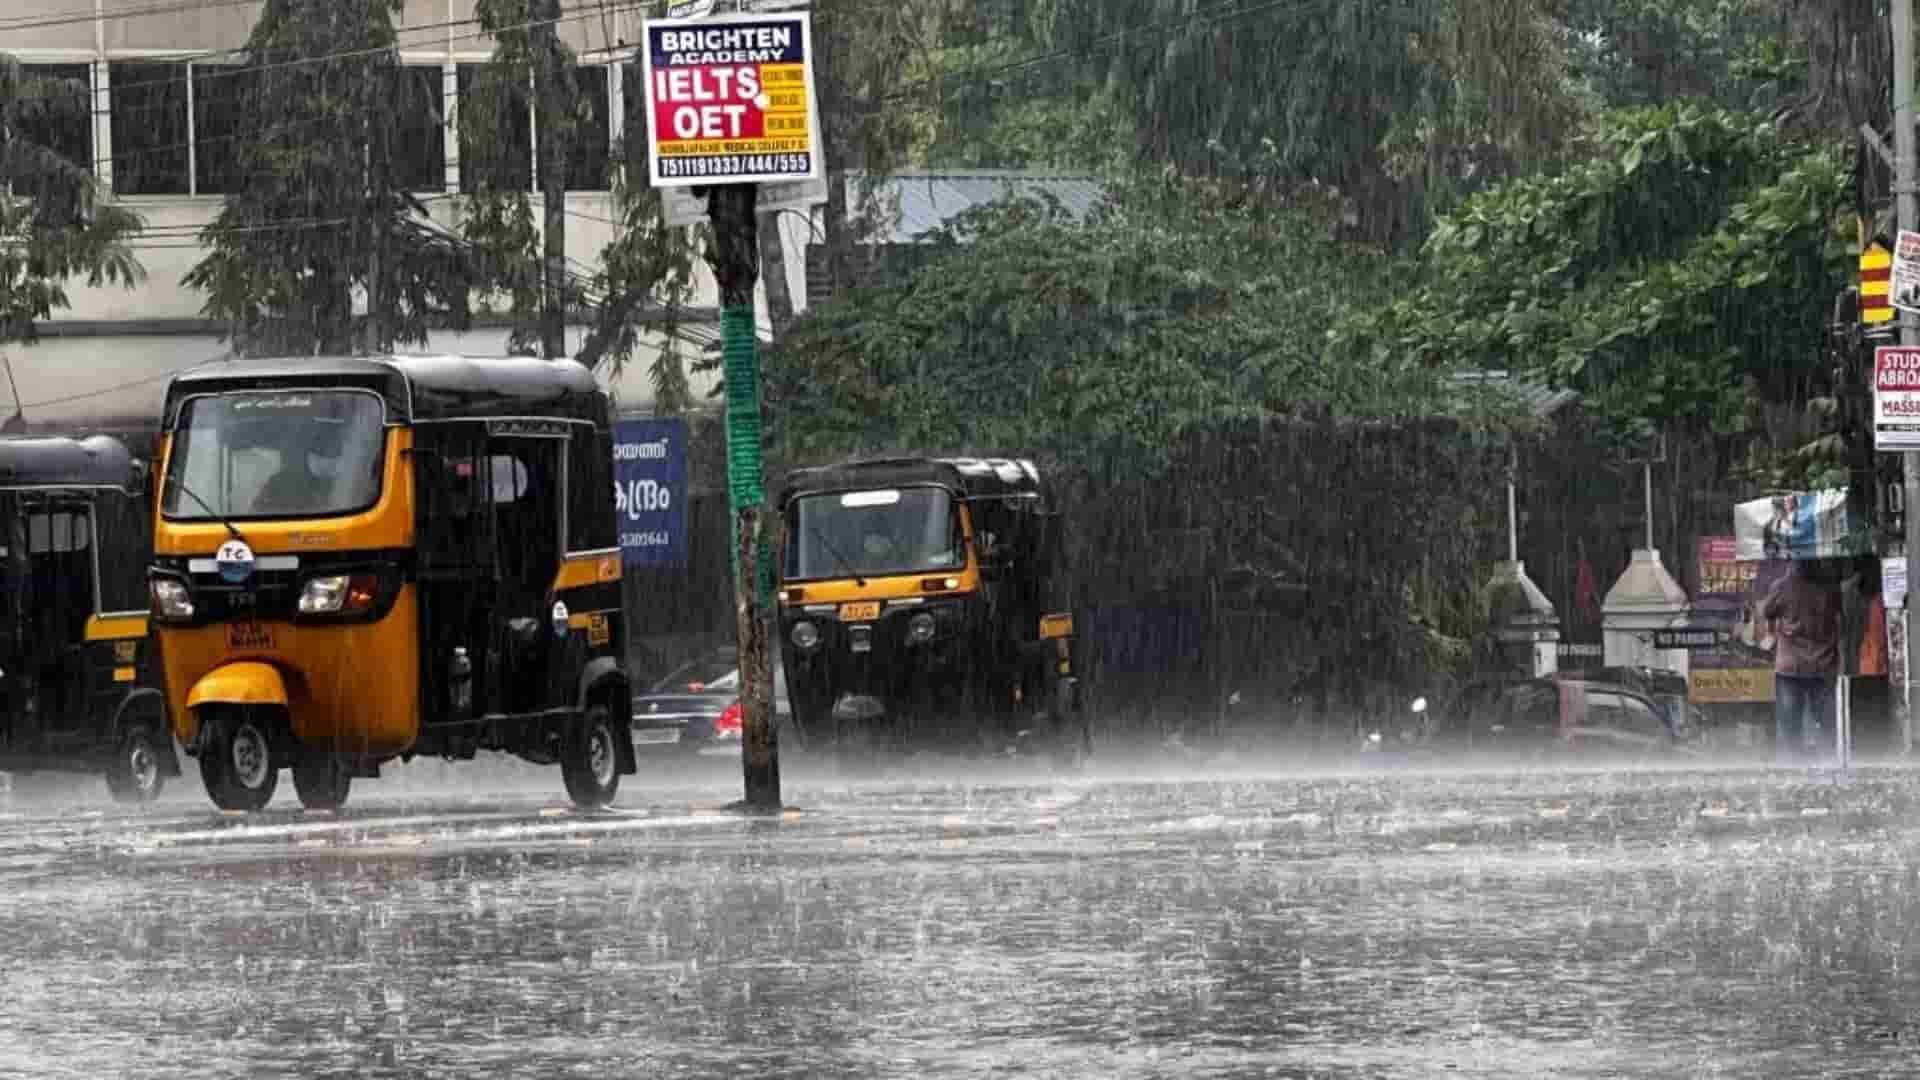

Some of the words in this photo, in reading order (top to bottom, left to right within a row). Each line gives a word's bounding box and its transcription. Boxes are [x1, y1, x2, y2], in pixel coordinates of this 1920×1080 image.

[661, 27, 791, 51] BRIGHTEN
[670, 48, 784, 64] ACADEMY
[655, 66, 758, 101] IELTS
[673, 104, 747, 138] OET
[662, 155, 808, 176] 7511191333/444/555
